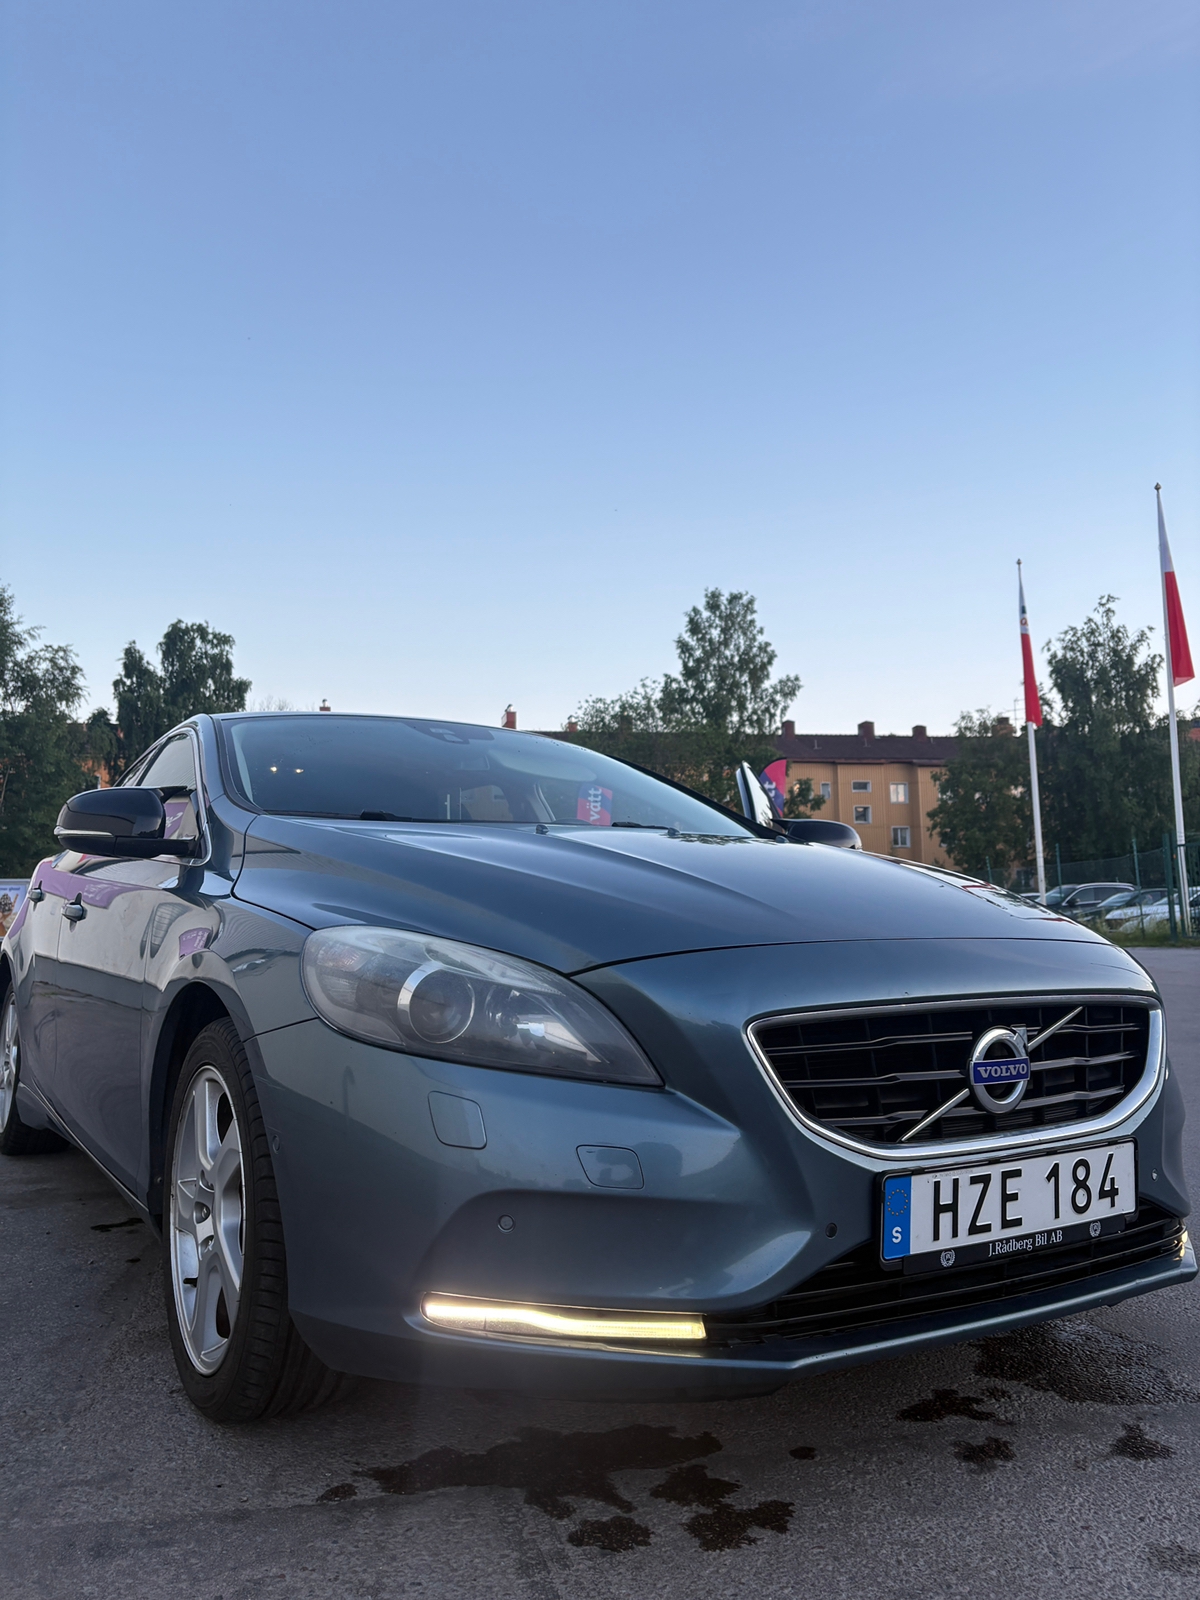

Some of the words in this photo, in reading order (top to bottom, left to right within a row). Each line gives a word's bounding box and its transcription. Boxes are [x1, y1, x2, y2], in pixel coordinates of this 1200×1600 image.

[586, 788, 602, 824] vätt
[977, 1063, 1027, 1078] VOLVO
[932, 1168, 1023, 1242] HZE
[1045, 1152, 1120, 1220] 184
[892, 1226, 902, 1244] S
[988, 1239, 1033, 1257] J.Rådberg
[1035, 1232, 1047, 1247] Bil
[1049, 1230, 1063, 1244] AB
